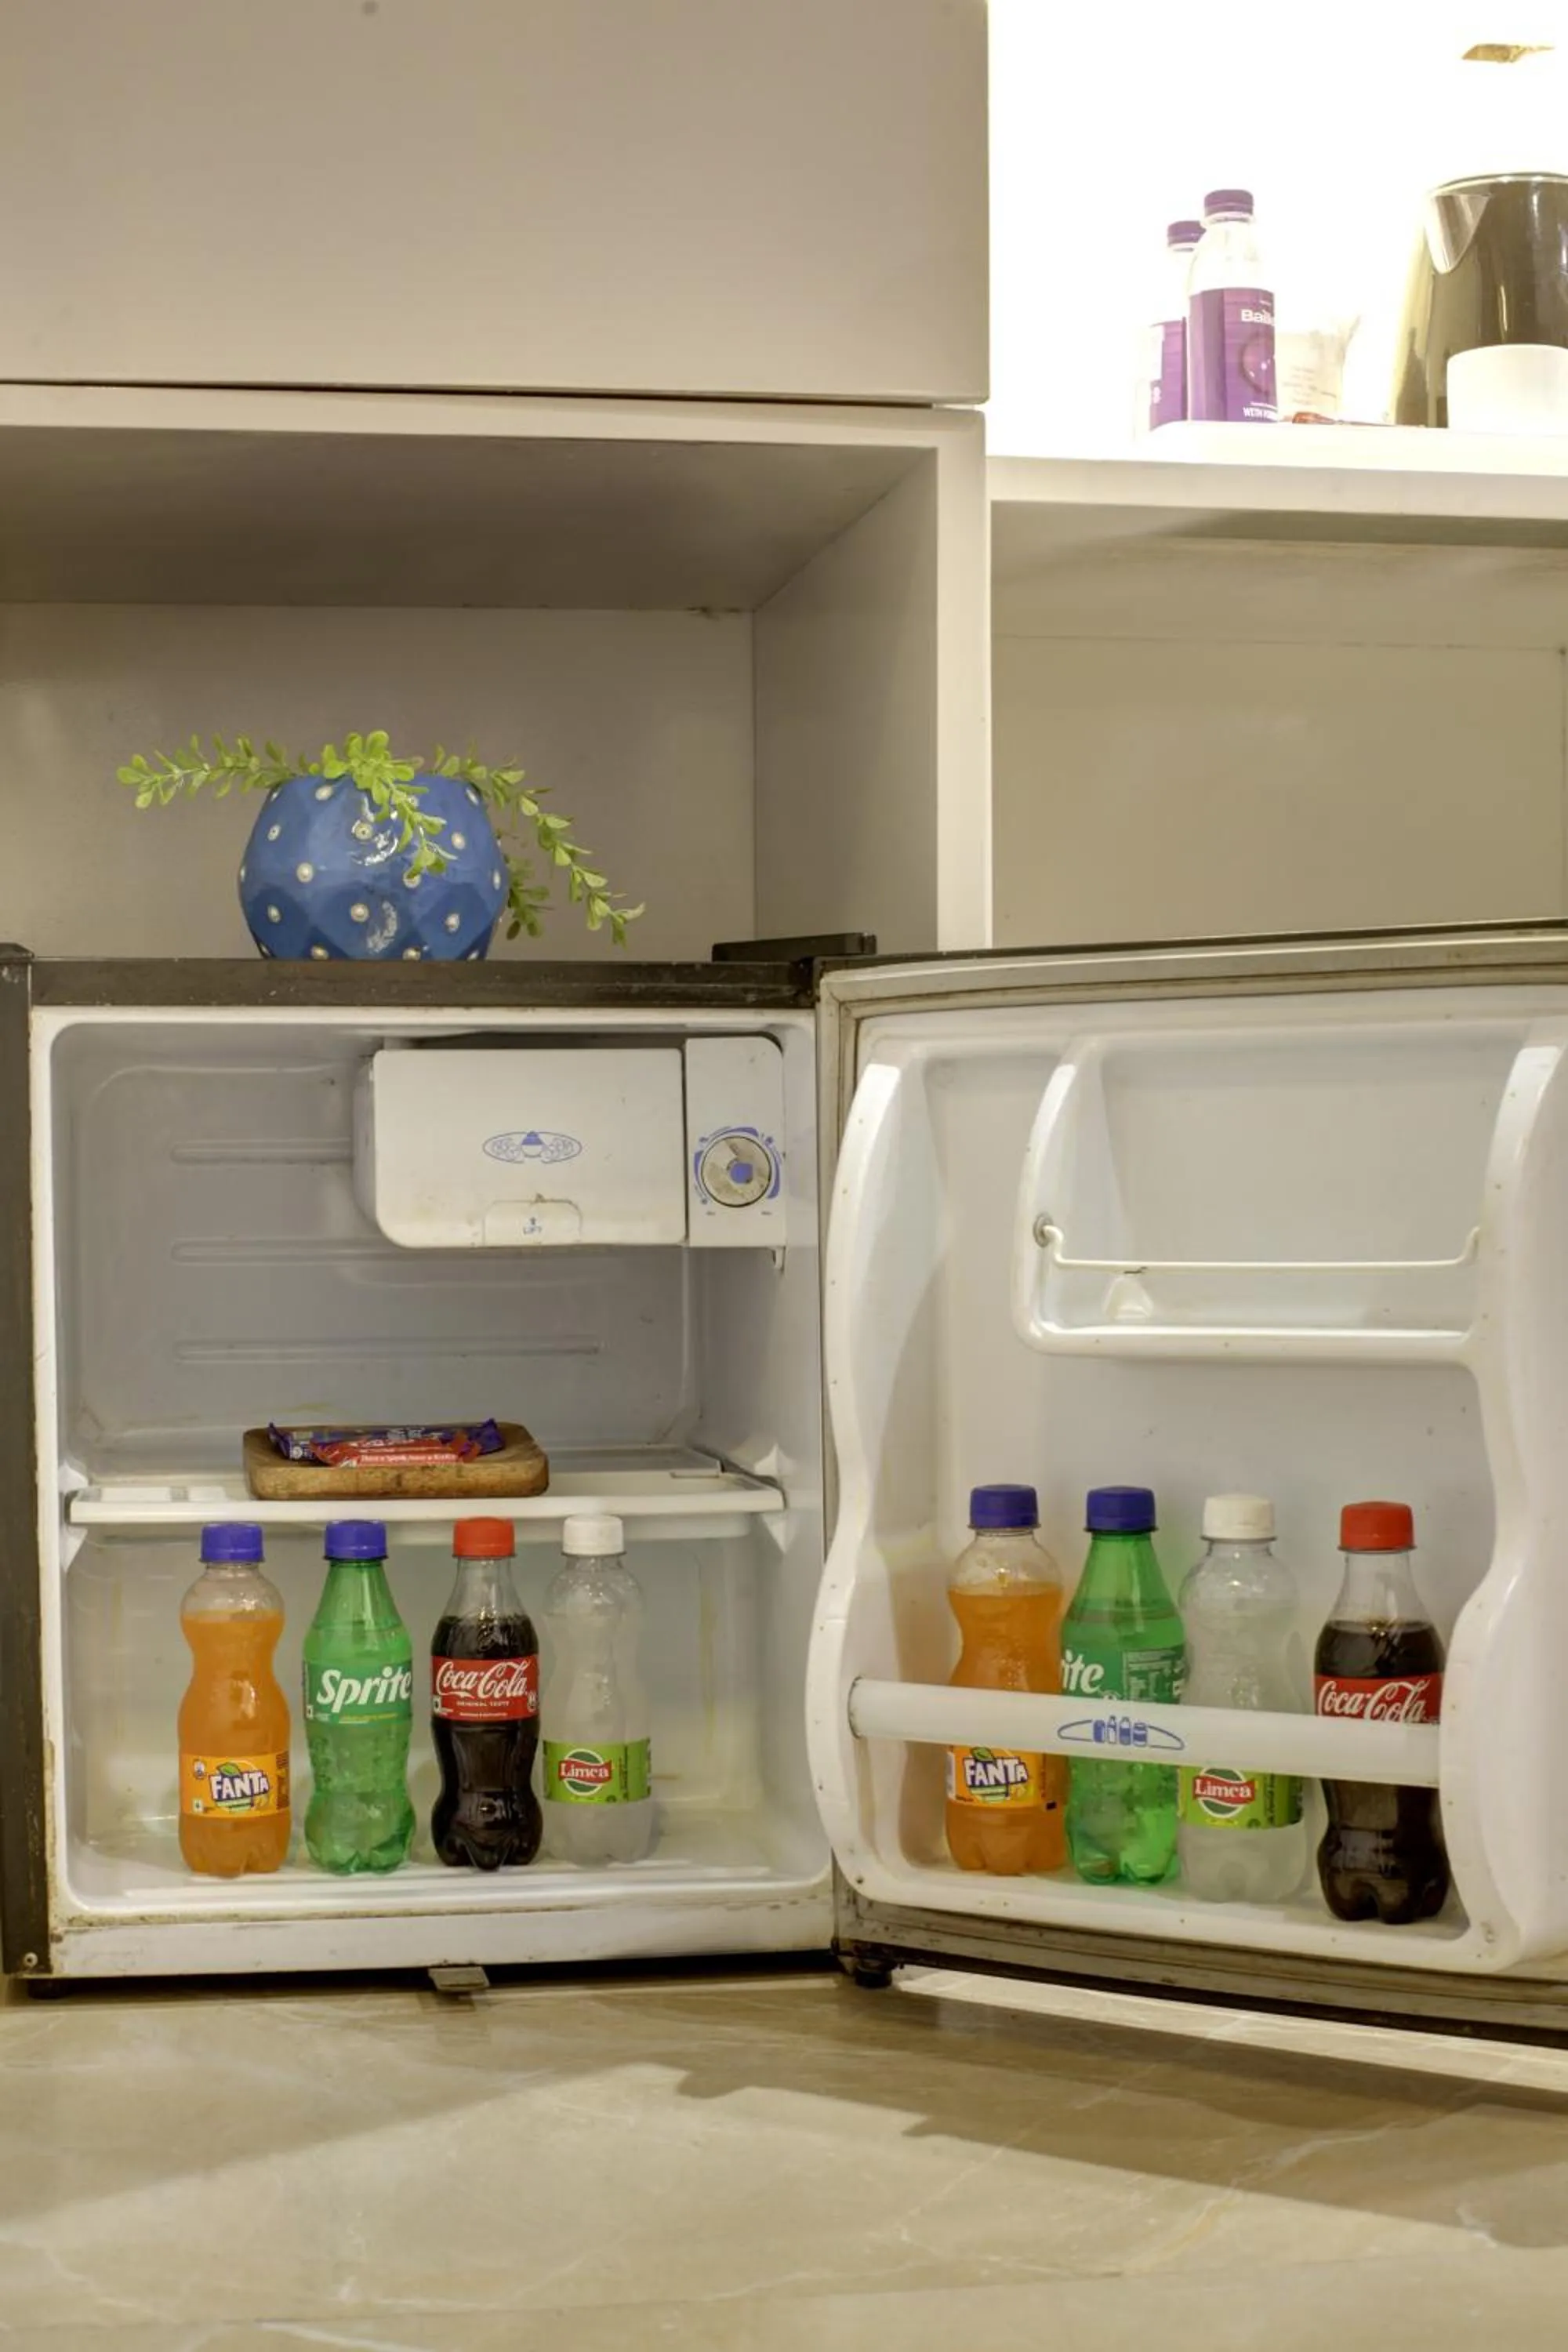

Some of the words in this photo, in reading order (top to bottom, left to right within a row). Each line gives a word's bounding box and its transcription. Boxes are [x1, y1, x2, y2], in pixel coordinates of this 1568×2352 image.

[316, 1665, 412, 1713] Sprite
[436, 1660, 530, 1699] Coca-Cola
[560, 1762, 610, 1778] Limca
[964, 1758, 1028, 1785] FANTA
[210, 1771, 269, 1800] FANTA
[1194, 1778, 1252, 1798] Limca
